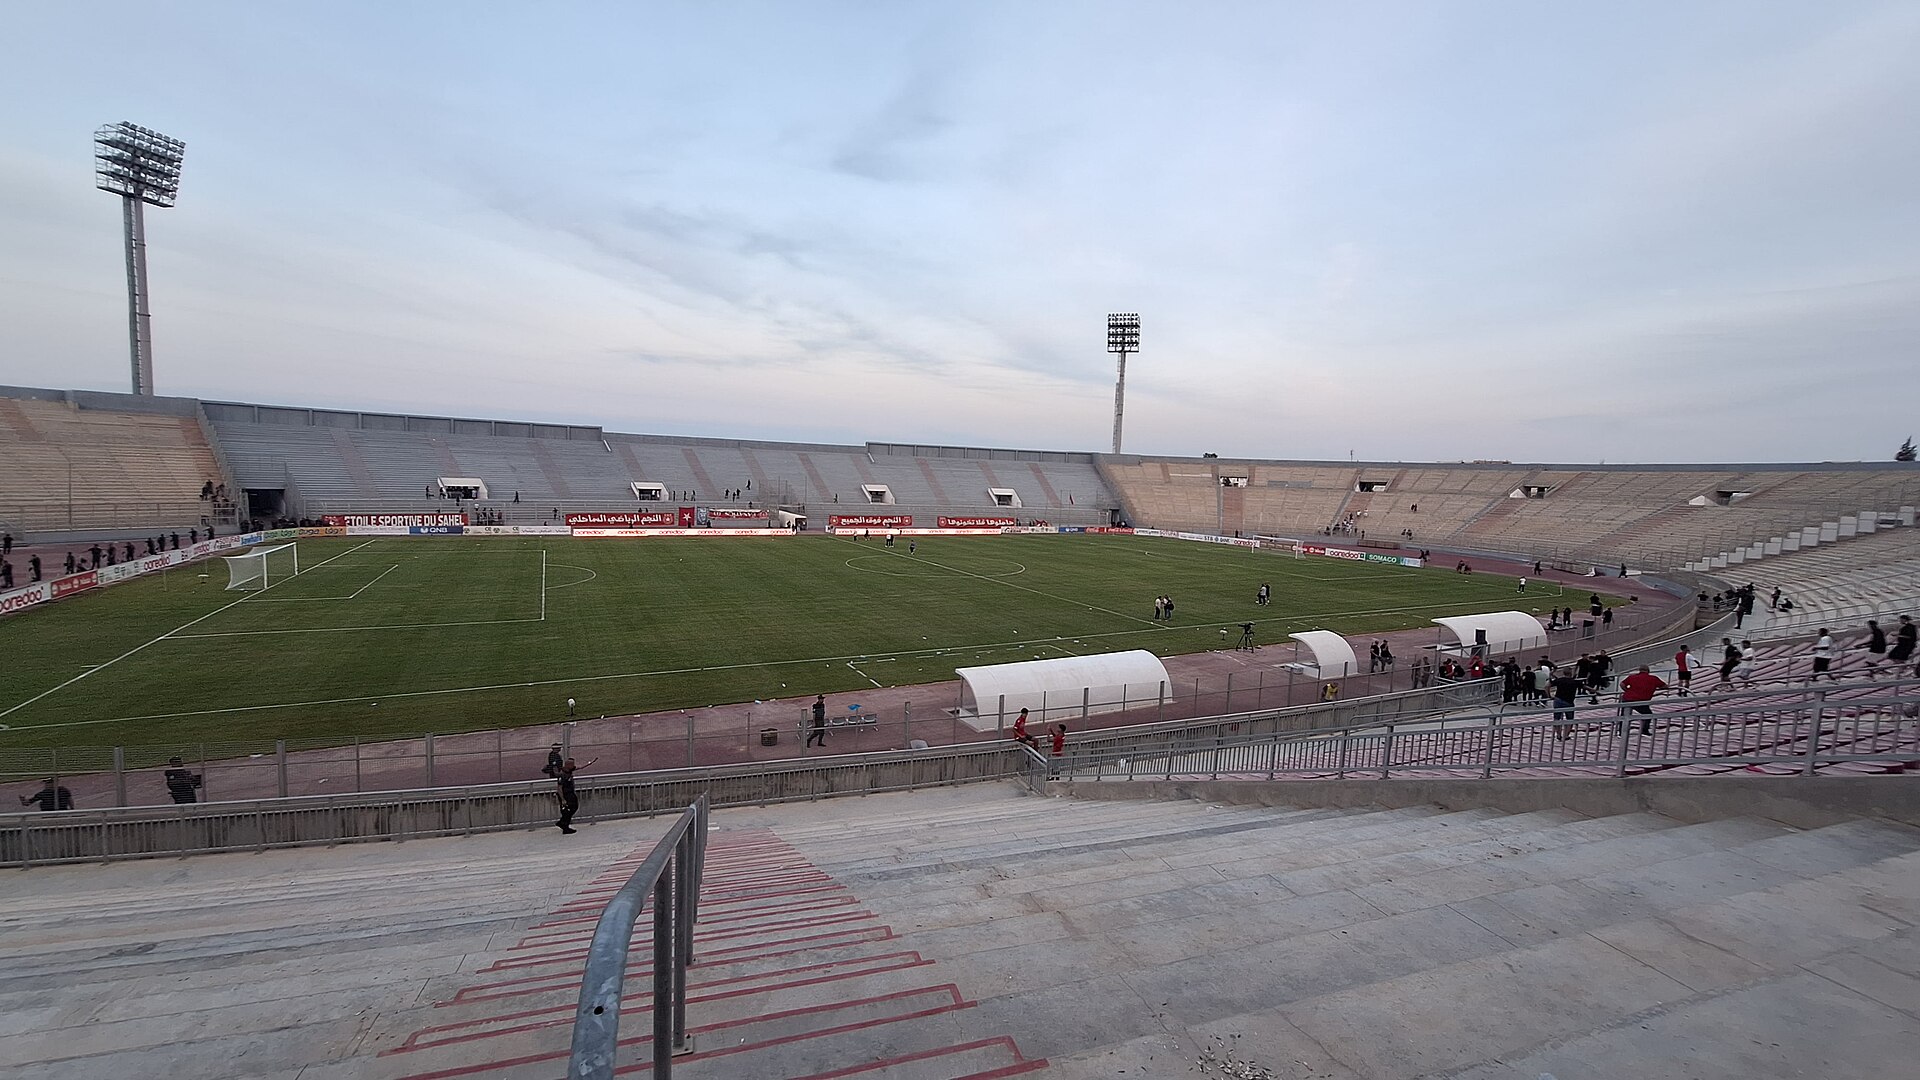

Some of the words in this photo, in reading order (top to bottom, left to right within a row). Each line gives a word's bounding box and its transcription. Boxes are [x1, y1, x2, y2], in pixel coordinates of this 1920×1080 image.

[344, 515, 376, 527] ETOILE
[378, 515, 422, 527] SPORTIVE
[424, 515, 436, 527] DU
[438, 514, 465, 526] SAHEL
[568, 514, 606, 525] الساحلي
[607, 514, 640, 525] الرياضي
[640, 514, 662, 525] النجم
[840, 516, 865, 525] الجميع
[882, 516, 902, 526] النجم
[1329, 550, 1359, 559] ooredoo
[1369, 554, 1397, 563] SOMACO
[144, 556, 171, 571] ooredoo
